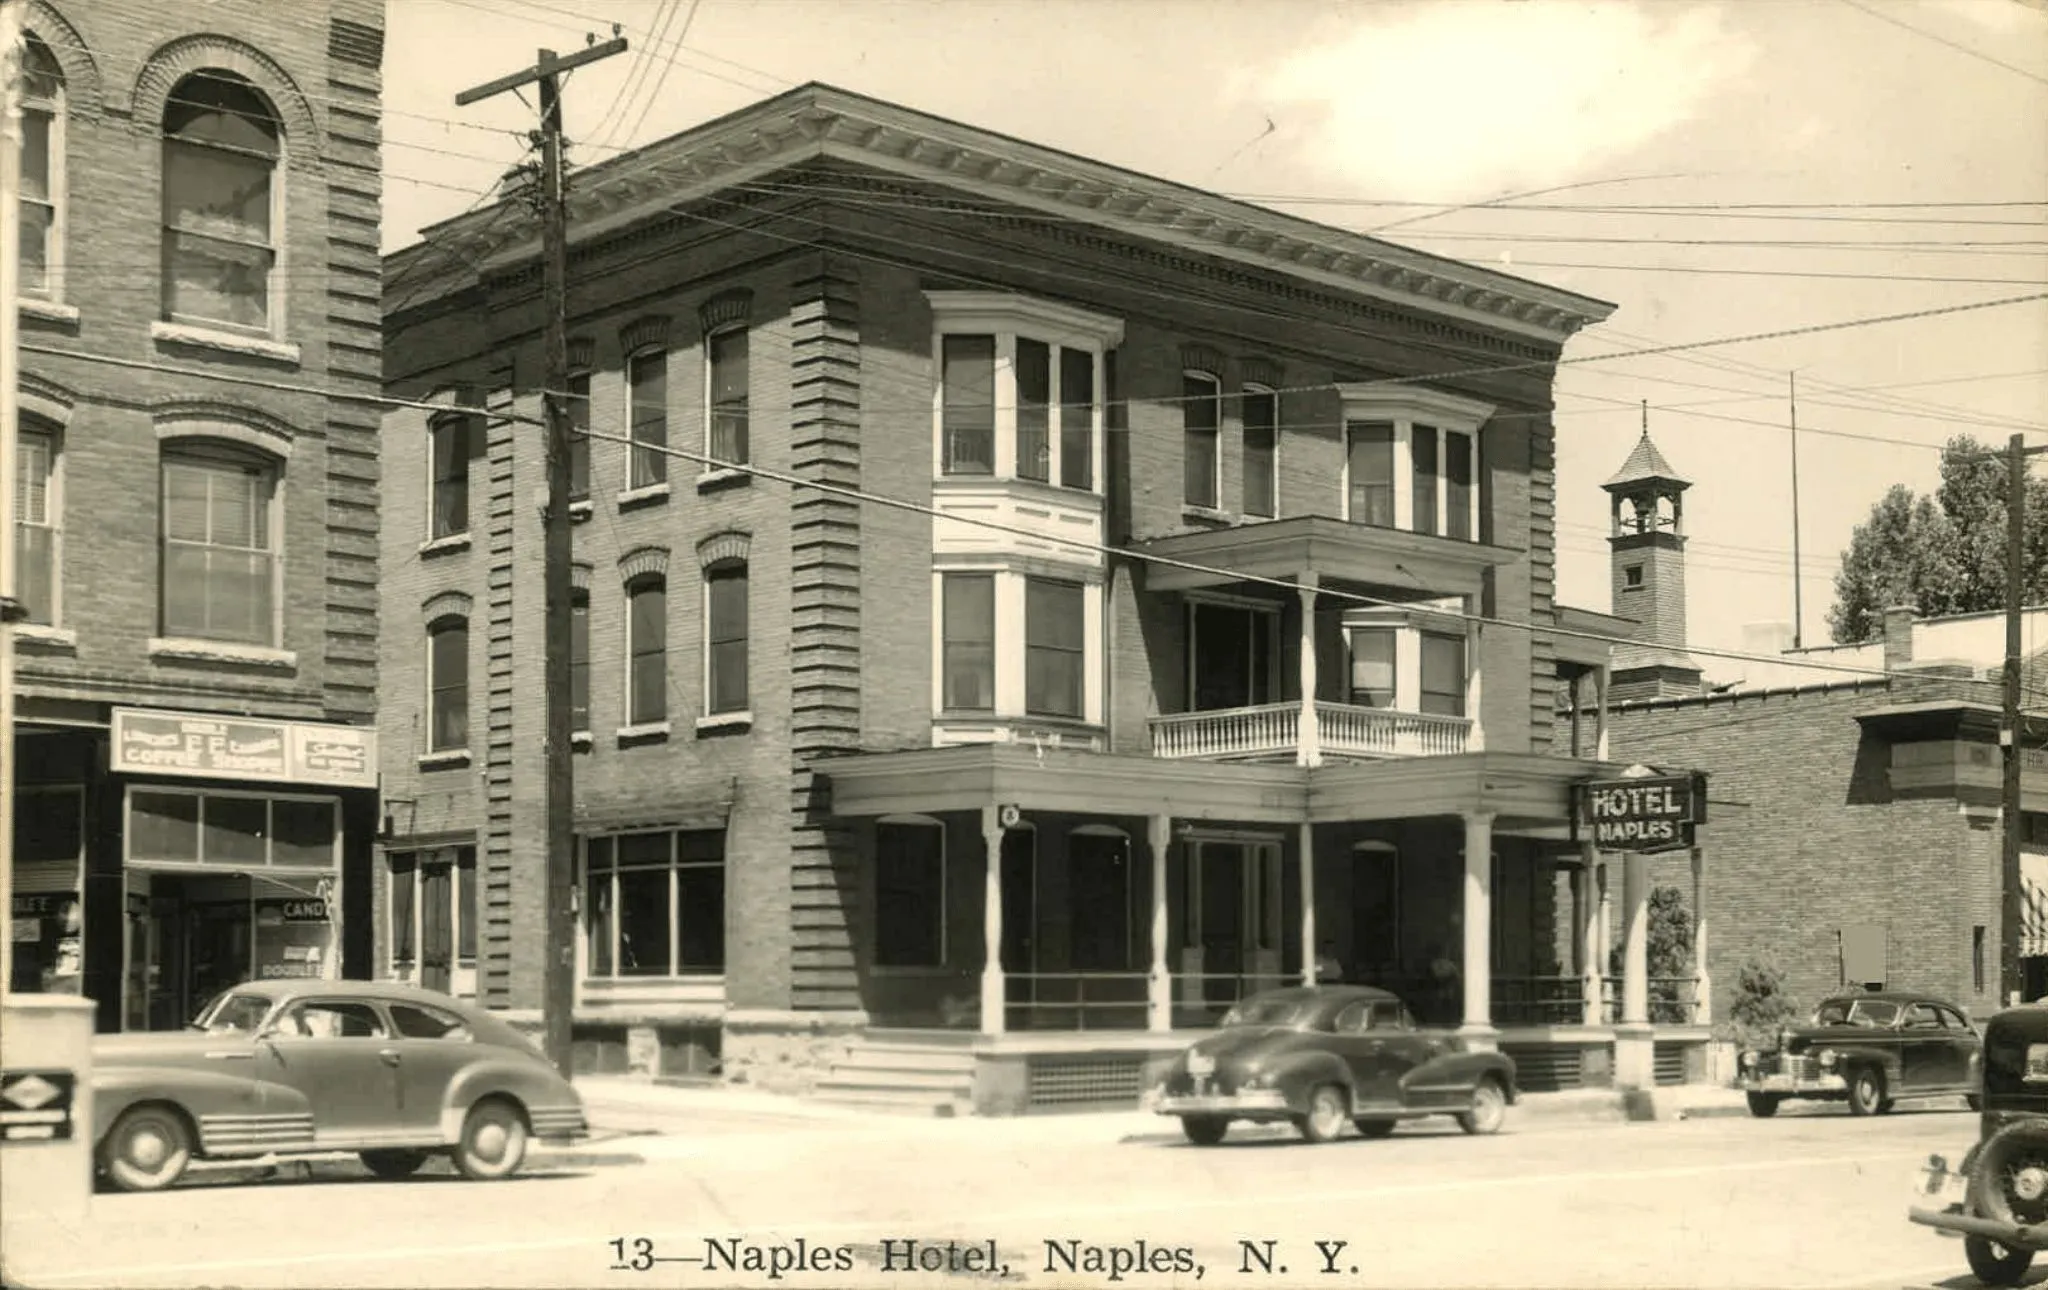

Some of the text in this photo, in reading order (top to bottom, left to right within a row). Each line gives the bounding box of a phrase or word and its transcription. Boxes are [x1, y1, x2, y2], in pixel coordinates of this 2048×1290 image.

[1590, 786, 1682, 817] HOTEL
[1597, 820, 1674, 841] NAPLES
[283, 901, 328, 918] CAND
